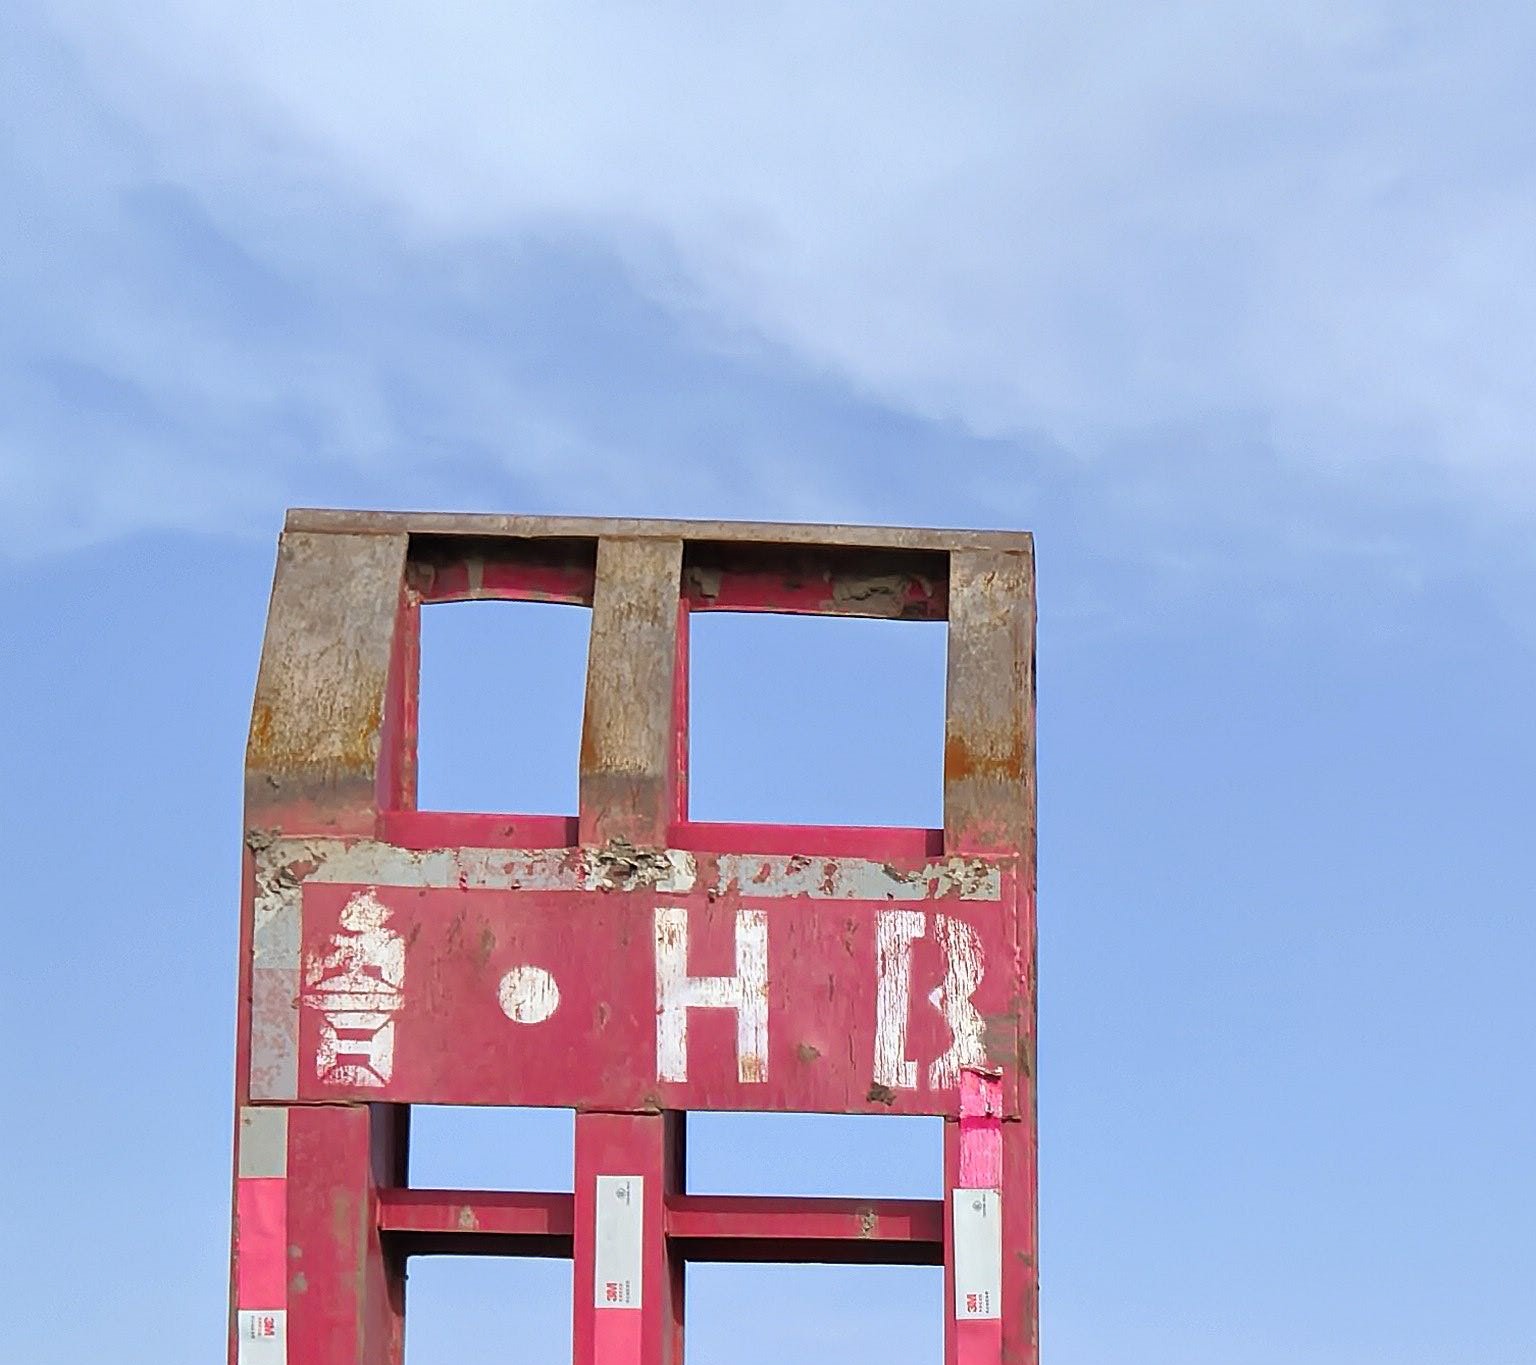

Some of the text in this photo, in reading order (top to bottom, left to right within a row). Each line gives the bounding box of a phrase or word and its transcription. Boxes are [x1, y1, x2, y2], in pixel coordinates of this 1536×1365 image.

[606, 1282, 618, 1301] 3M
[966, 1293, 977, 1312] 3M
[263, 1316, 274, 1337] 3M
